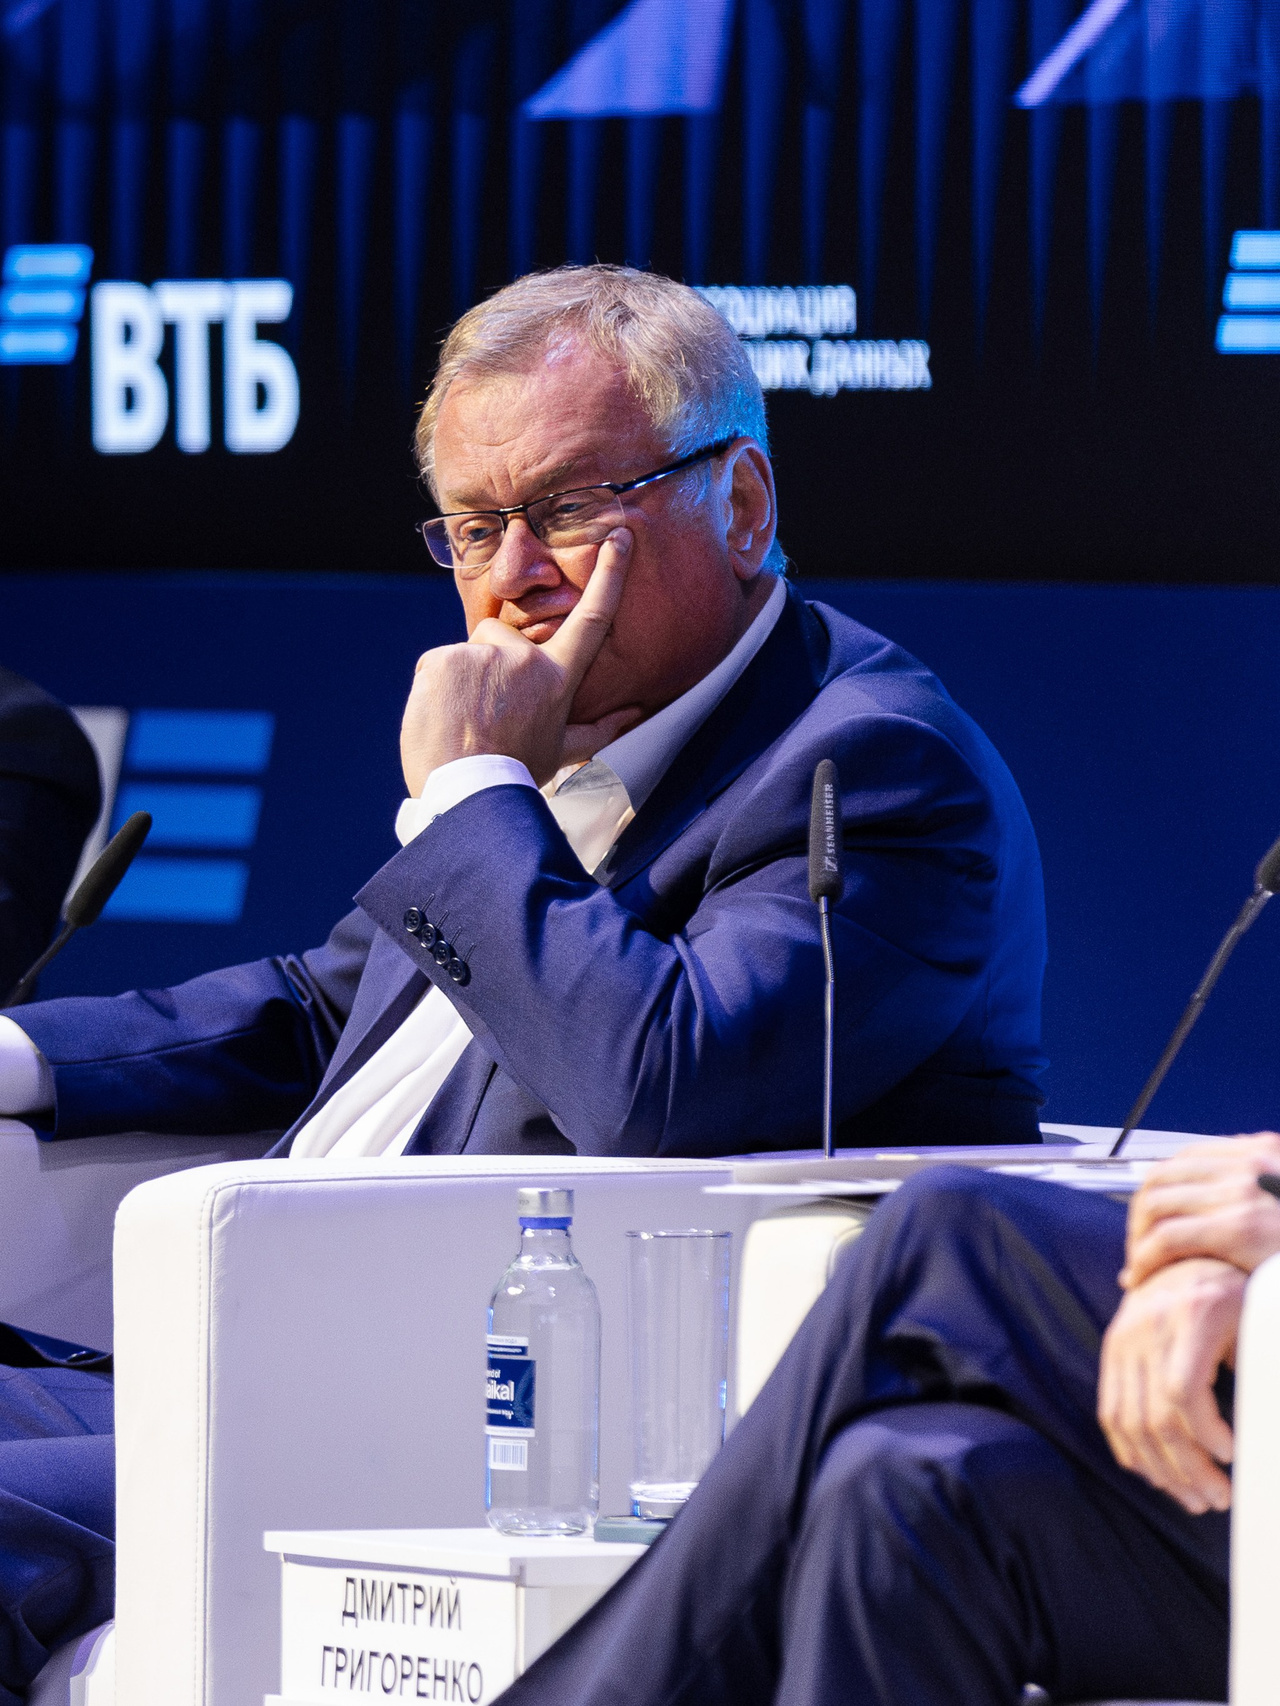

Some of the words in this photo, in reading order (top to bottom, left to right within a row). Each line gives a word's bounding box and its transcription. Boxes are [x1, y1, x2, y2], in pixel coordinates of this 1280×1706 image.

[91, 278, 300, 454] ВТБ
[824, 783, 835, 854] SENNHEISER
[342, 1576, 462, 1631] ДМИТРИЙ
[321, 1645, 484, 1704] ГРИГОРЕНКО
